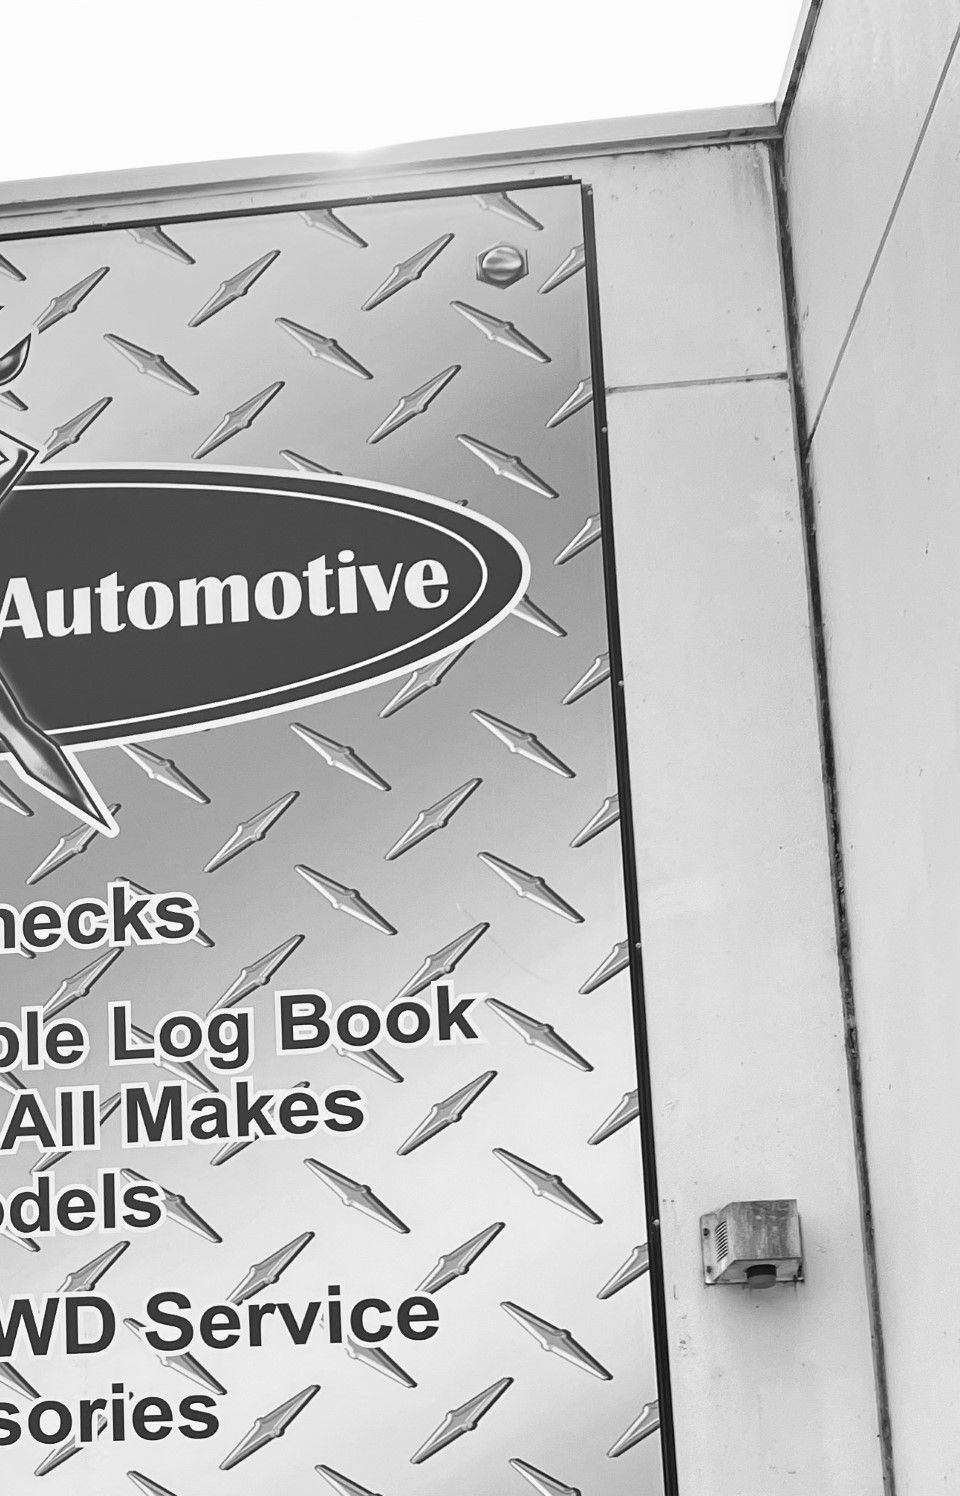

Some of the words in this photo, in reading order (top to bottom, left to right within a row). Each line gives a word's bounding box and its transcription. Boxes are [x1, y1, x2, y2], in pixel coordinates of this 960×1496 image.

[113, 1005, 249, 1070] Log
[280, 984, 479, 1051] Book
[0, 1089, 96, 1150] All
[126, 1080, 365, 1144] Makes
[144, 1285, 440, 1351] Service
